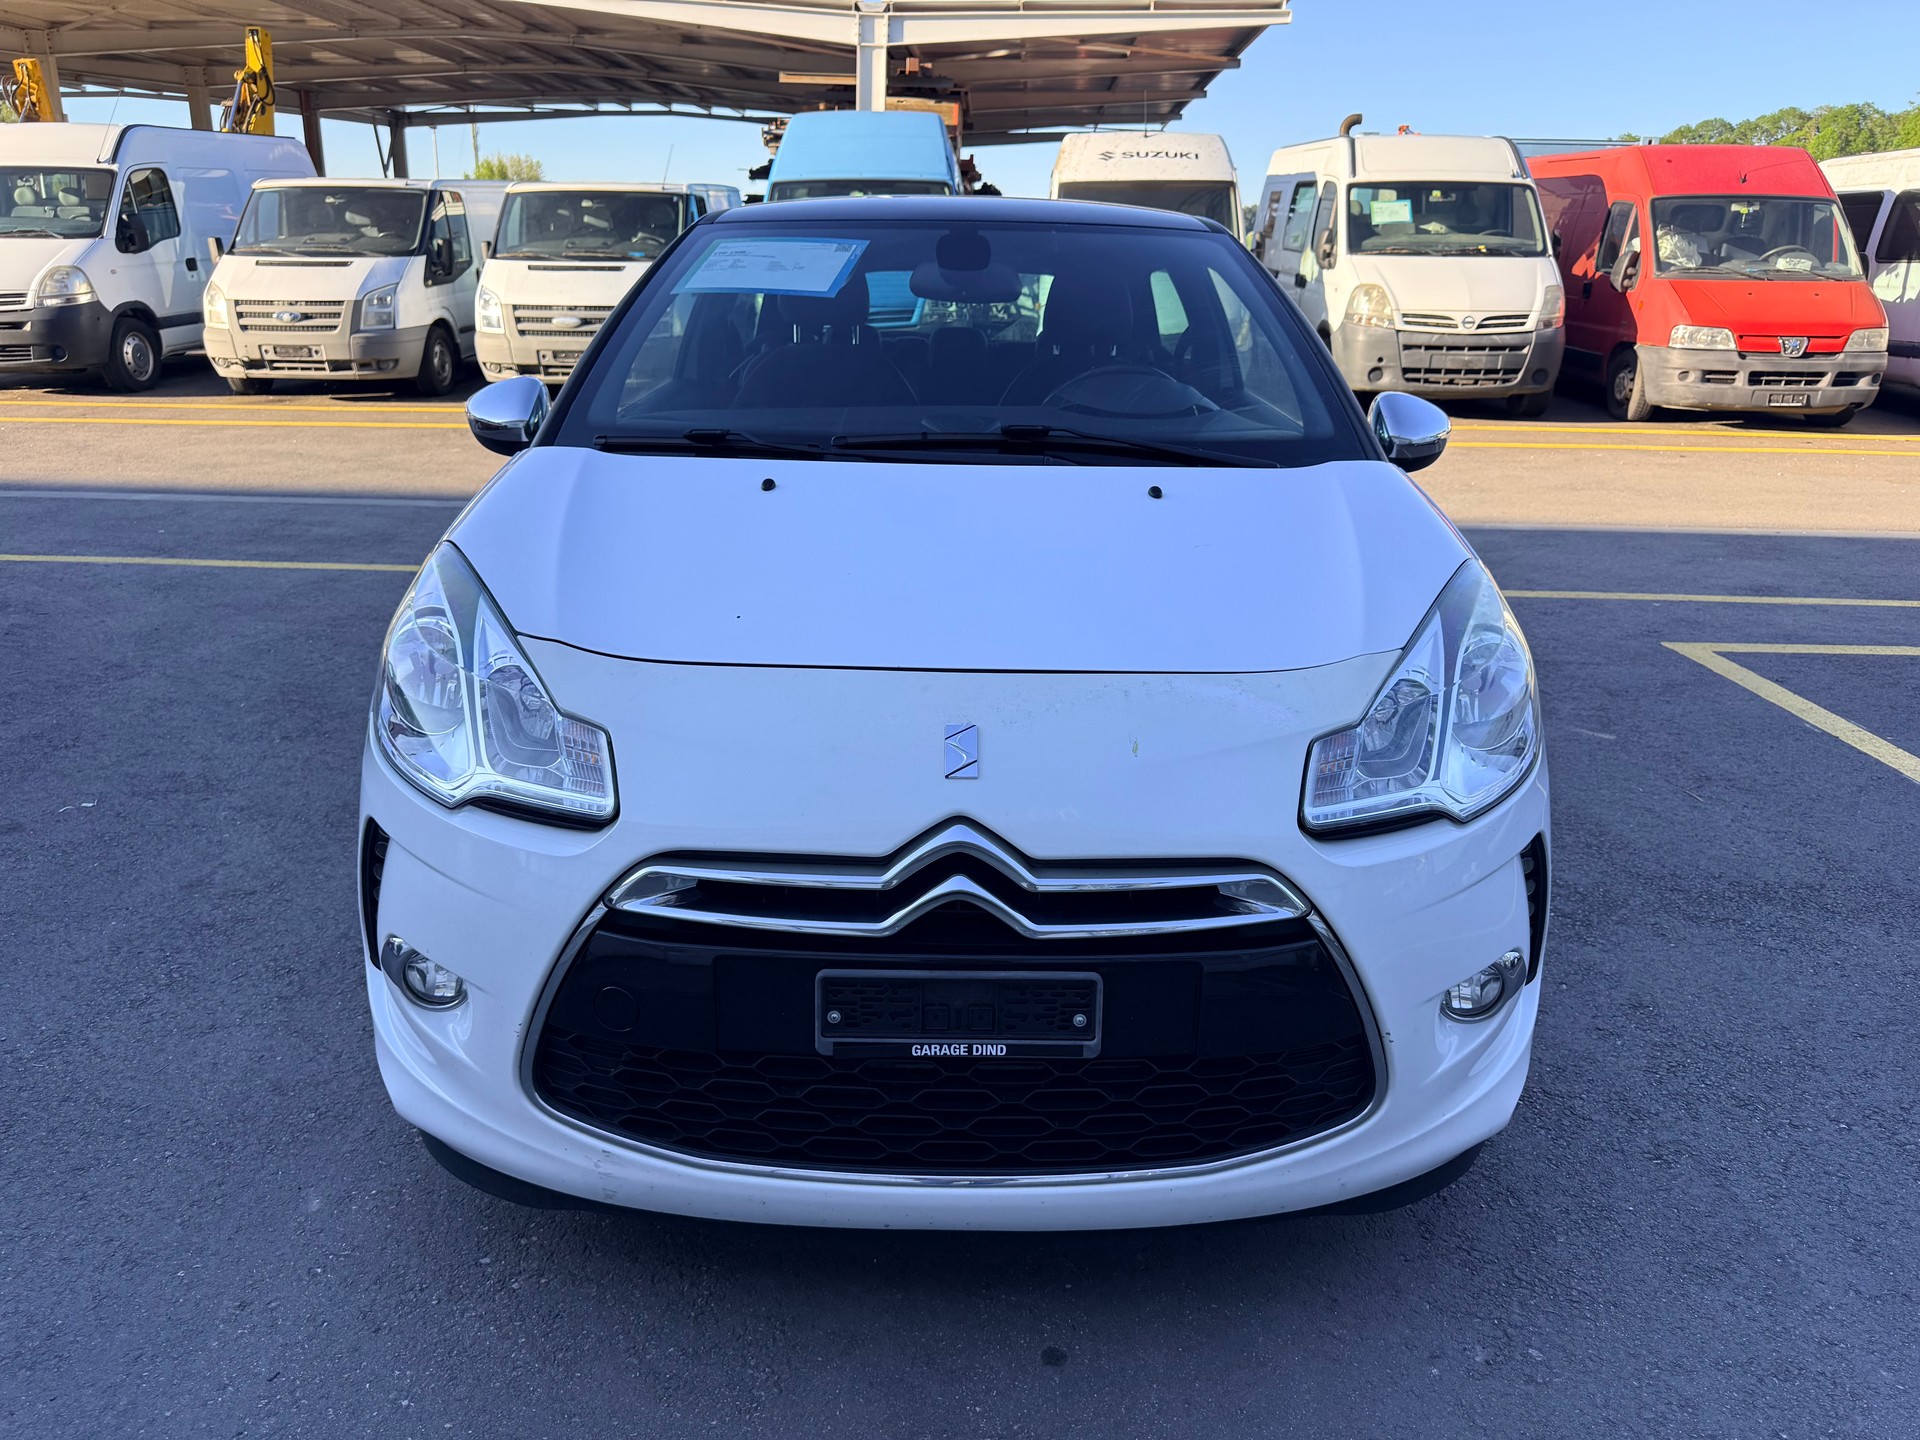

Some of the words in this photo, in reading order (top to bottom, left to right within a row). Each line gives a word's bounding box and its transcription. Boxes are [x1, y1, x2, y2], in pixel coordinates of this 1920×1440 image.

[1121, 151, 1199, 160] SUZUKI
[911, 1044, 969, 1056] GARAGE
[972, 1044, 1007, 1056] DIND
